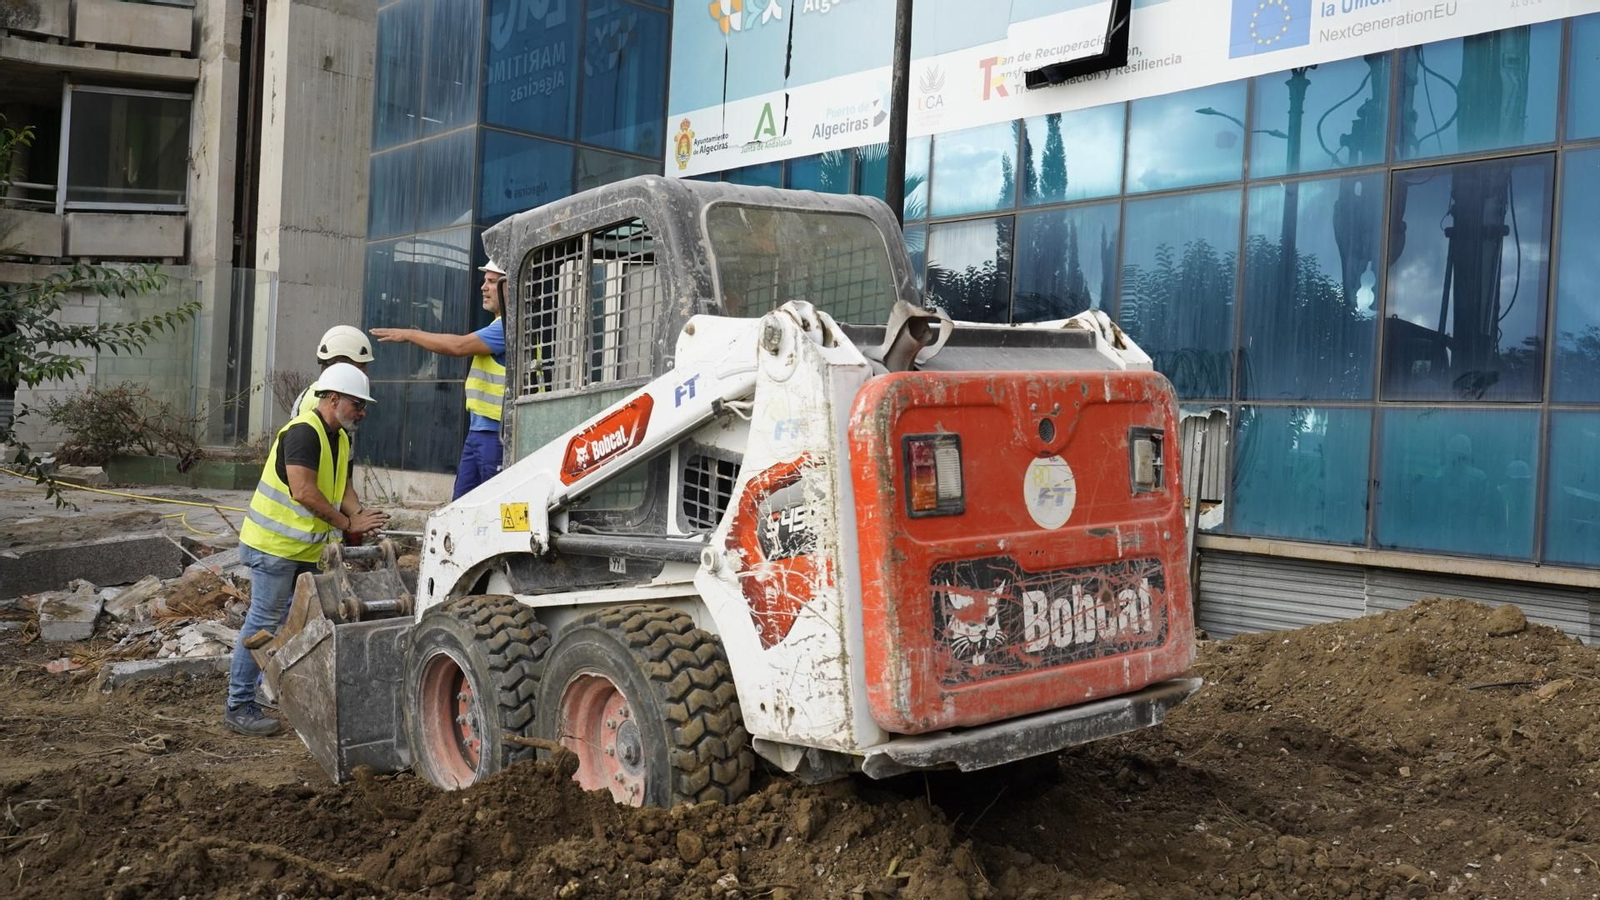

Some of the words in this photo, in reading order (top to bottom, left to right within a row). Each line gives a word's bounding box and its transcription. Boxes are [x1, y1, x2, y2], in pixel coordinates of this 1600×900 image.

[1321, 2, 1335, 18] la
[1319, 4, 1458, 43] NextGenerationEU
[1017, 51, 1032, 62] de
[1115, 53, 1183, 76] Resiliencia
[917, 94, 944, 111] UCA
[826, 105, 856, 120] Puerto
[812, 118, 869, 140] Algeciras
[693, 133, 729, 147] Ayuntamiento
[740, 144, 756, 154] Junta
[757, 142, 764, 151] de
[765, 137, 792, 149] Andalucía
[699, 142, 729, 156] Algeciras
[674, 373, 700, 408] FT
[591, 426, 630, 460] Bobcat
[1022, 577, 1153, 653] Bobcat
